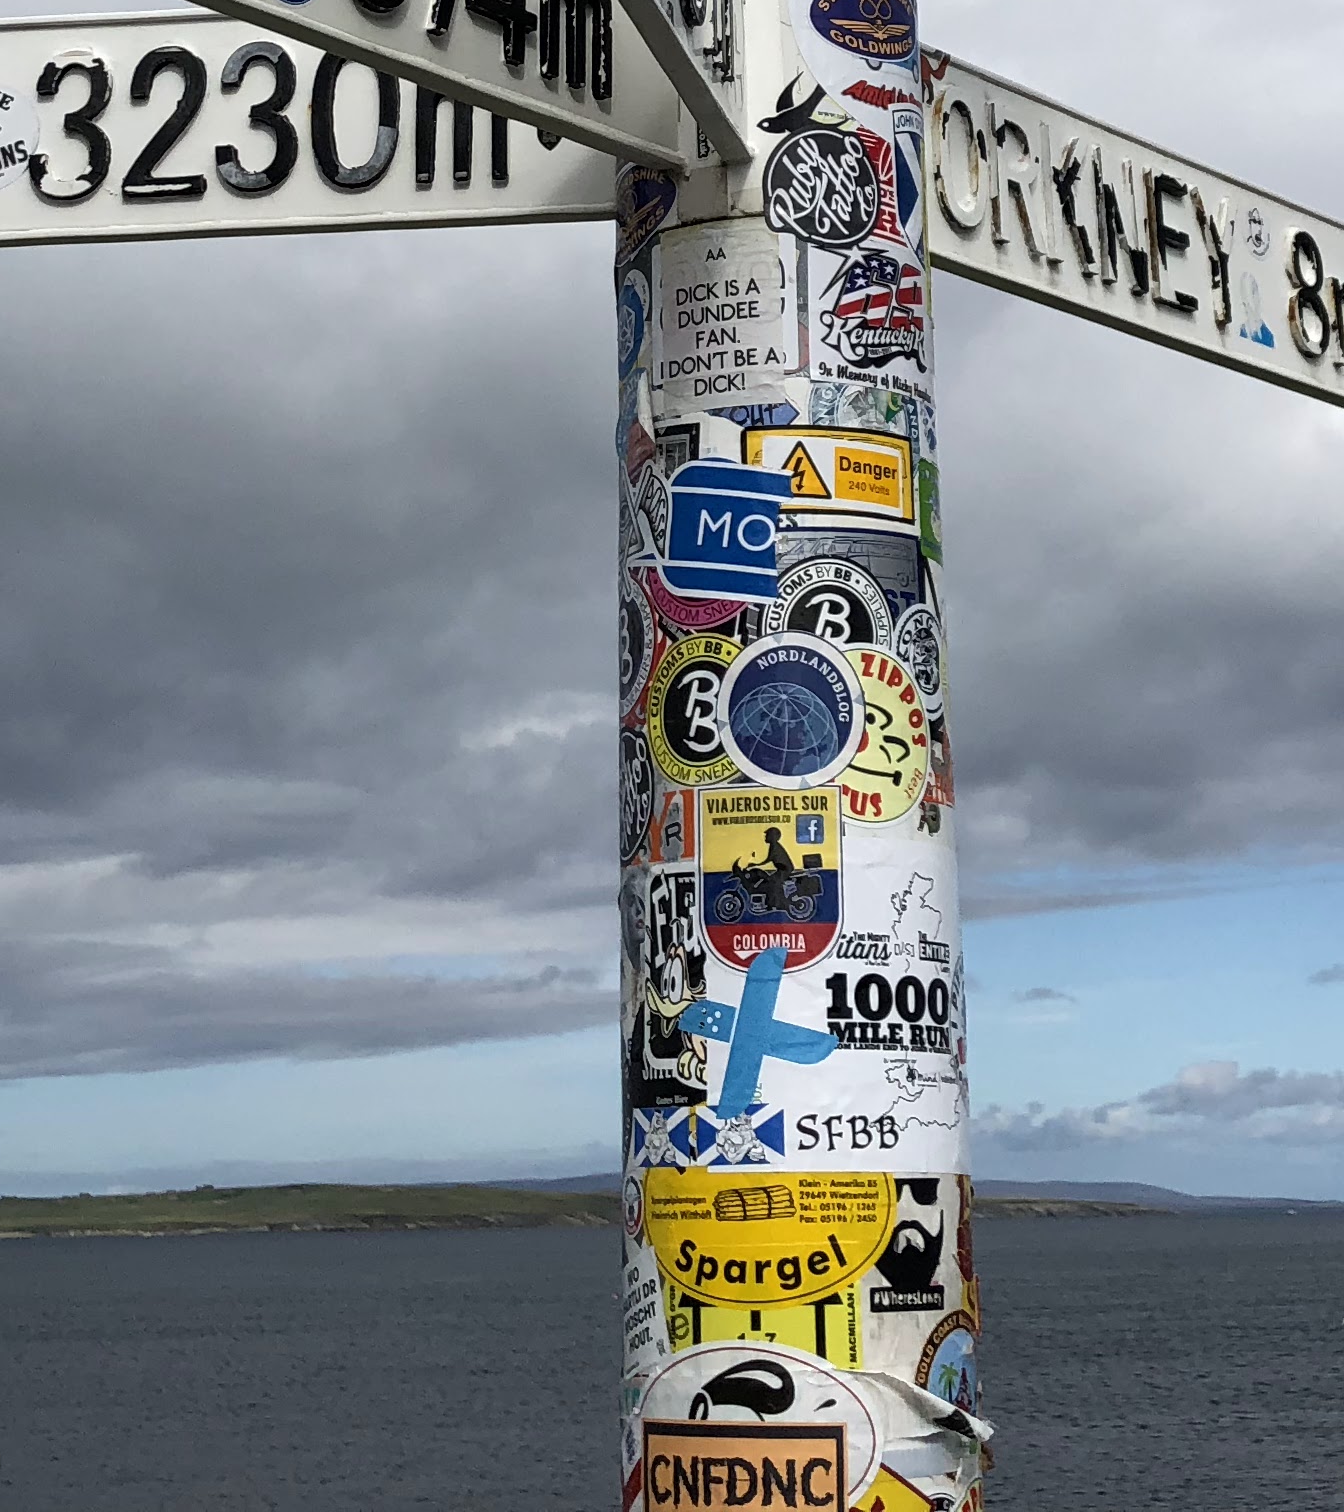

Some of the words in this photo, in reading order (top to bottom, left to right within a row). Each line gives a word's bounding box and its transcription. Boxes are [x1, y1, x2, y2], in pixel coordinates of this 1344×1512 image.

[29, 39, 511, 201] 3230m
[770, 137, 828, 237] Ruby
[816, 136, 864, 235] Tattoo
[933, 92, 1235, 330] ORKNEY
[705, 247, 727, 262] AA
[676, 283, 720, 306] DICK
[725, 280, 739, 298] IS
[745, 278, 761, 295] A
[678, 300, 760, 329] DUNDEE
[695, 326, 741, 349] FAN.
[820, 310, 914, 361] Kentucky
[669, 352, 728, 379] DON'T
[734, 350, 758, 366] BE
[764, 347, 780, 364] A
[694, 373, 746, 396] DICK!
[837, 364, 878, 387] Memory
[839, 456, 898, 480] Danger
[849, 480, 866, 491] 240
[869, 483, 890, 495] Volts
[657, 589, 699, 621] CUSTOM
[769, 569, 813, 631] CUSTOMS
[815, 566, 832, 578] BY
[834, 567, 852, 582] BB
[862, 584, 889, 646] SUPPLIES
[650, 651, 686, 718] CUSTOMS
[687, 641, 702, 655] BY
[704, 640, 723, 656] BB
[757, 649, 850, 723] NORDLANDBLOG
[861, 652, 927, 748] ZIPPOS
[655, 735, 691, 781] CUSTOM
[706, 796, 771, 813] VIAJEROS
[774, 796, 796, 811] DEL
[802, 796, 829, 811] SUR
[733, 934, 806, 950] COLOMBIA
[825, 972, 949, 1025] 1000
[827, 1022, 904, 1045] MILE
[909, 1025, 950, 1048] RUN
[797, 1114, 900, 1151] SFBB
[675, 1233, 848, 1290] Spargel
[847, 1292, 857, 1363] MACMILLAN
[651, 1455, 834, 1509] CNFDNC
